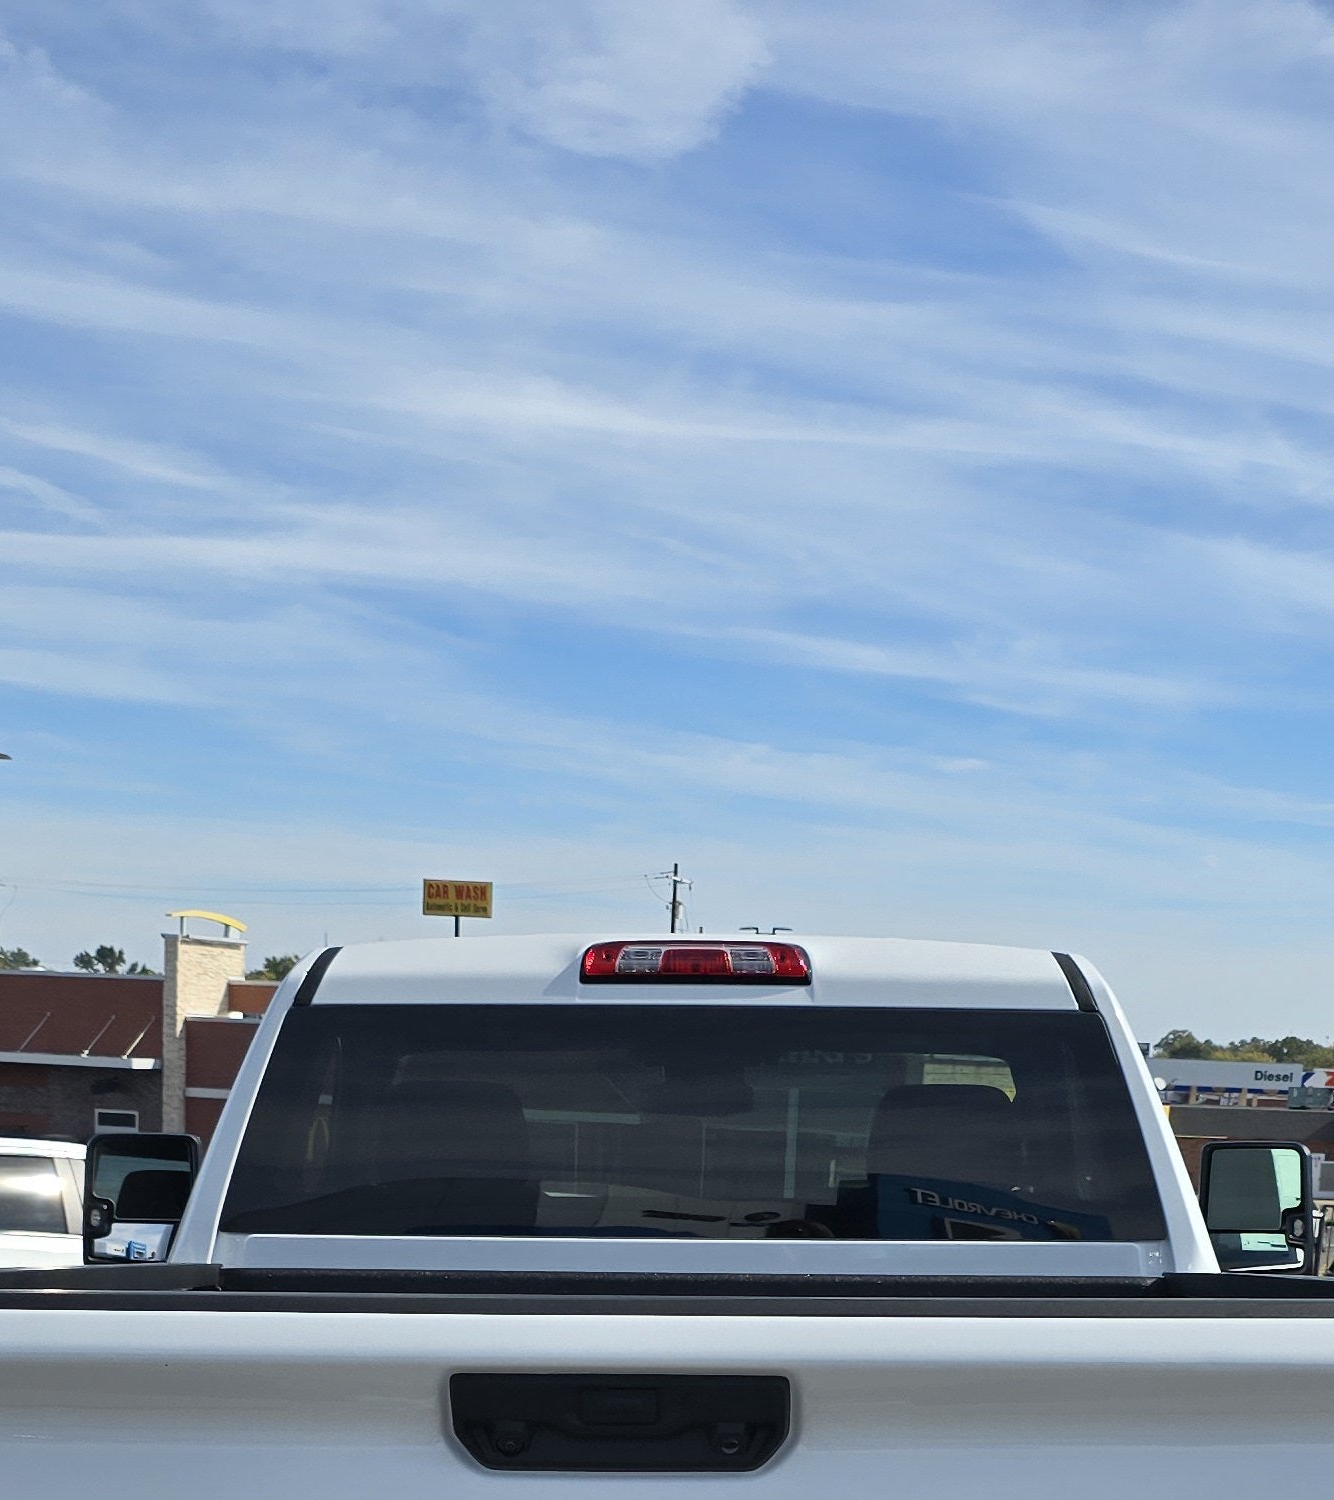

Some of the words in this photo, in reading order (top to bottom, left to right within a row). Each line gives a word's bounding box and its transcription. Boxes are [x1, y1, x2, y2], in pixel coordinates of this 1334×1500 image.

[427, 883, 449, 899] CAR
[455, 884, 487, 901] WASH
[1254, 1070, 1293, 1083] Diesel
